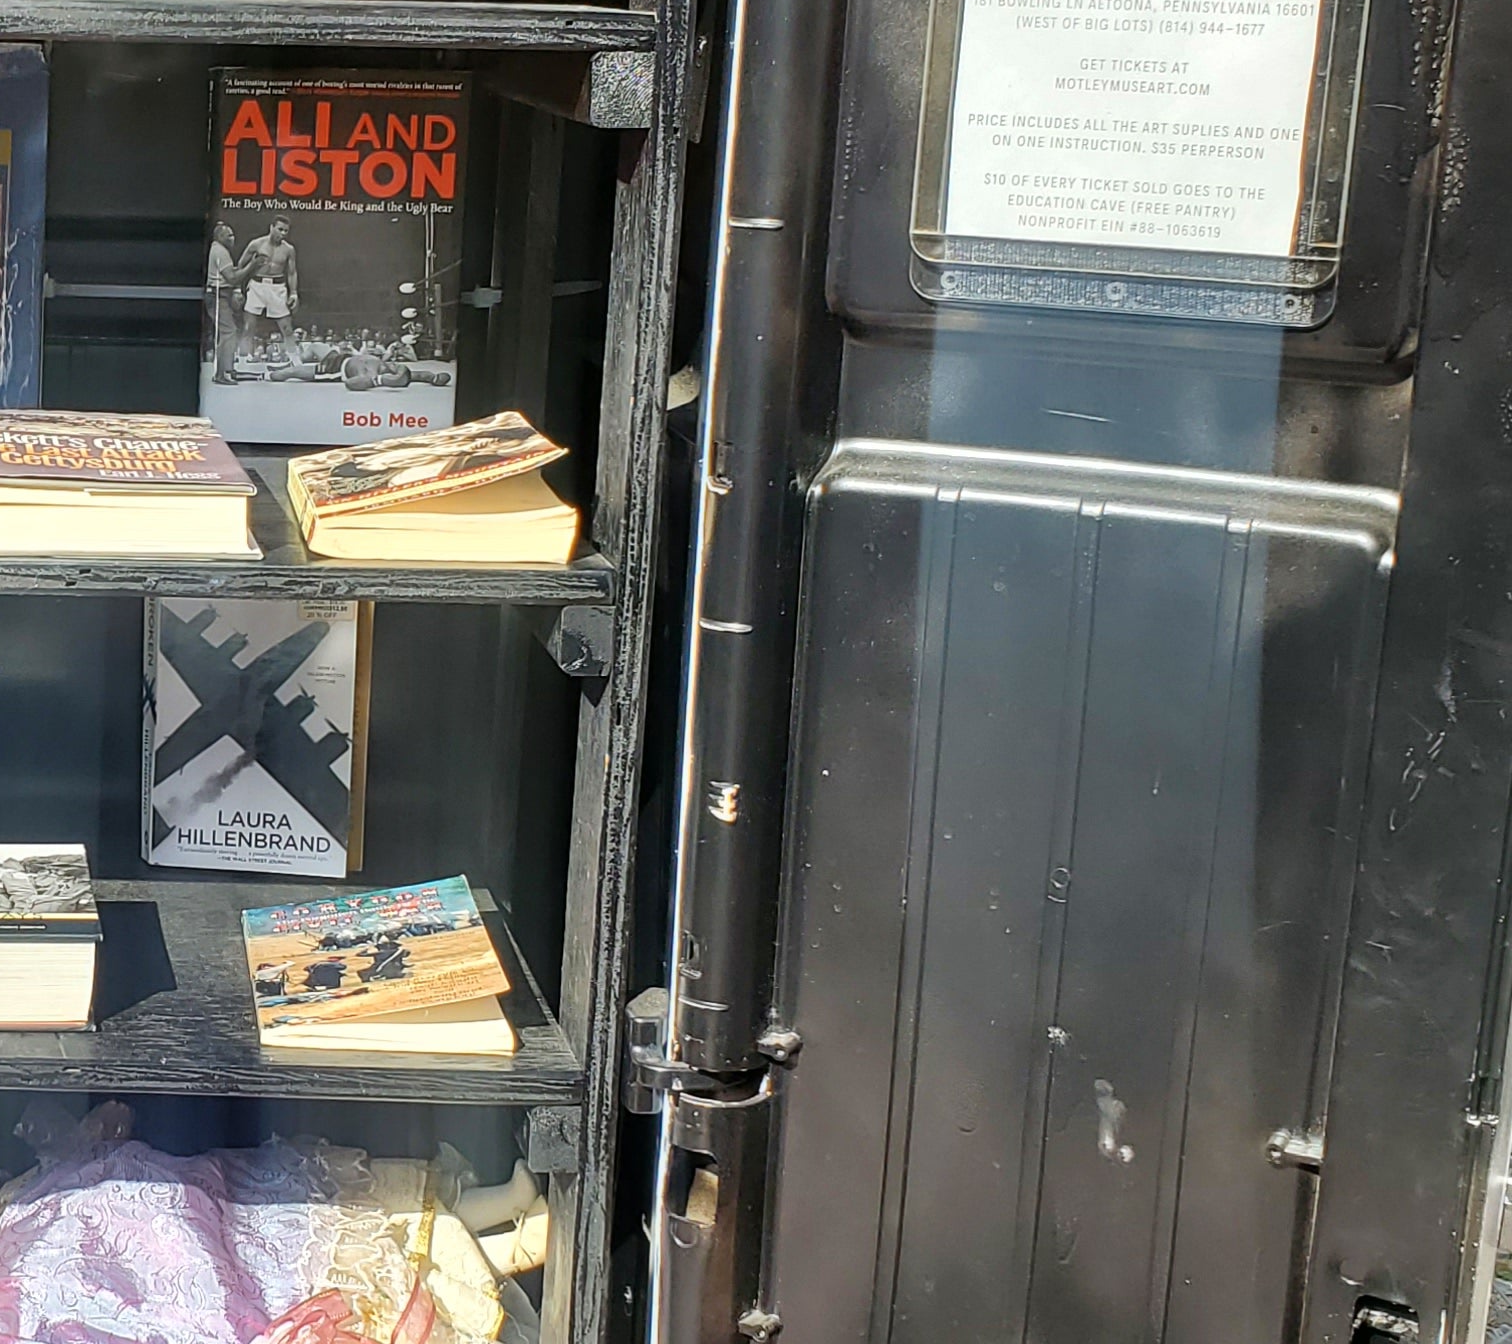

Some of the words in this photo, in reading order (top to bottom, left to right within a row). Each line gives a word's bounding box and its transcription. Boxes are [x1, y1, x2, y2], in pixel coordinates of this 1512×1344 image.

[1162, 0, 1271, 15] PENNSYLVANIA
[1276, 3, 1315, 17] 16601
[1016, 16, 1058, 29] (WEST
[1062, 17, 1082, 30] OF
[1086, 18, 1109, 31] BIG
[1113, 19, 1154, 33] LOTS)
[1159, 19, 1194, 35] (814)
[1199, 22, 1265, 36] 944-1677
[1080, 58, 1106, 72] GET
[1112, 59, 1166, 74] TICKETS
[1171, 62, 1190, 74] AT
[1054, 77, 1210, 96] MOTLEYMUSEART.COM
[223, 99, 332, 149] ALI
[346, 112, 457, 152] AND
[968, 113, 1008, 127] PRICE
[1012, 115, 1079, 130] INCLUDES
[1083, 118, 1108, 132] ALL
[1112, 120, 1138, 133] THE
[1141, 121, 1168, 135] ART
[1172, 123, 1229, 138] SUPLIES
[1233, 125, 1264, 139] AND
[1270, 128, 1300, 142] ONE
[992, 134, 1012, 146] ON
[1016, 135, 1046, 149] ONE
[1050, 136, 1147, 154] INSTRUCTION.
[1151, 141, 1177, 155] $35
[1181, 143, 1265, 160] PERPERSON
[221, 149, 456, 199] LISTON
[983, 173, 1007, 186] $10
[1011, 174, 1030, 187] OF
[1034, 176, 1077, 190] EVERY
[1081, 178, 1129, 193] TICKET
[1132, 181, 1168, 195] SOLD
[1173, 183, 1210, 197] GOES
[1215, 185, 1234, 199] TO
[1239, 187, 1266, 200] THE
[221, 198, 240, 209] The
[244, 199, 263, 211] Boy
[264, 199, 287, 210] Who
[289, 199, 322, 211] Would
[324, 200, 337, 211] Be
[340, 200, 364, 214] King
[365, 201, 384, 212] and
[387, 201, 403, 213] the
[405, 202, 428, 216] Ugly
[430, 203, 453, 214] Bear
[1007, 194, 1086, 209] EDUCATION
[1091, 199, 1126, 213] CAVE
[1130, 201, 1170, 216] (FREE
[1175, 204, 1236, 220] PANTRY)
[1018, 214, 1096, 230] NONPROFIT
[1101, 219, 1124, 232] EIN
[1129, 221, 1221, 238] #88-1063619
[342, 411, 381, 428] Bob
[389, 413, 429, 429] Mee
[0, 452, 177, 474] Gettysburg
[25, 442, 91, 457] Last
[101, 448, 207, 462] Attack
[218, 810, 292, 830] LAURA
[178, 827, 331, 853] HILLENBRAND
